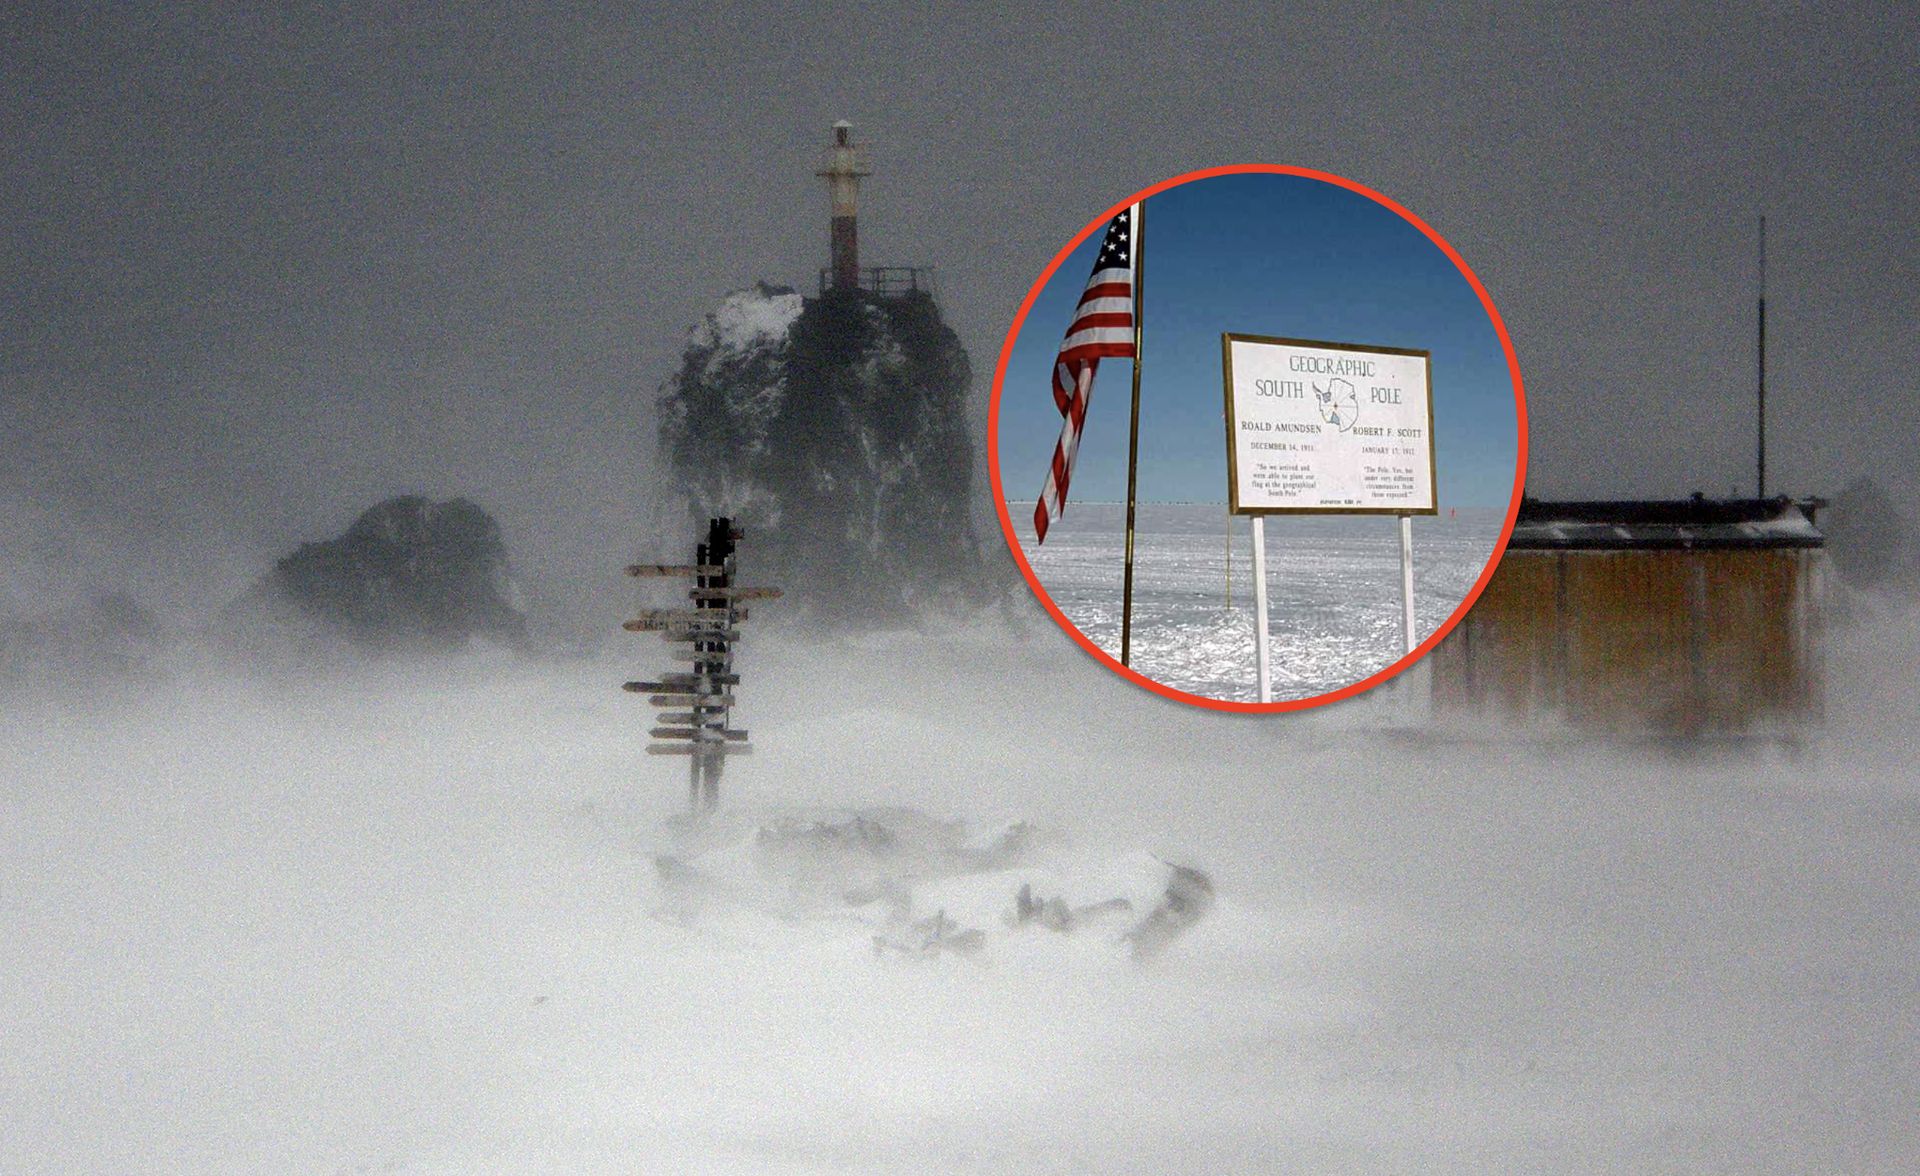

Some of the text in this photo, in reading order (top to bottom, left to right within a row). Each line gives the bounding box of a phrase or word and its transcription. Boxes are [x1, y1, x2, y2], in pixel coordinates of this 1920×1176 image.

[1290, 355, 1376, 377] GEOGRAPHIC
[1255, 379, 1402, 405] SOUTH POLE
[1241, 421, 1322, 434] ROALD AMUNDSEN
[1353, 427, 1383, 436] ROBERT
[1397, 428, 1422, 438] SCOTT
[1251, 442, 1287, 451] DECEMBER
[1362, 446, 1389, 454] JANUARY
